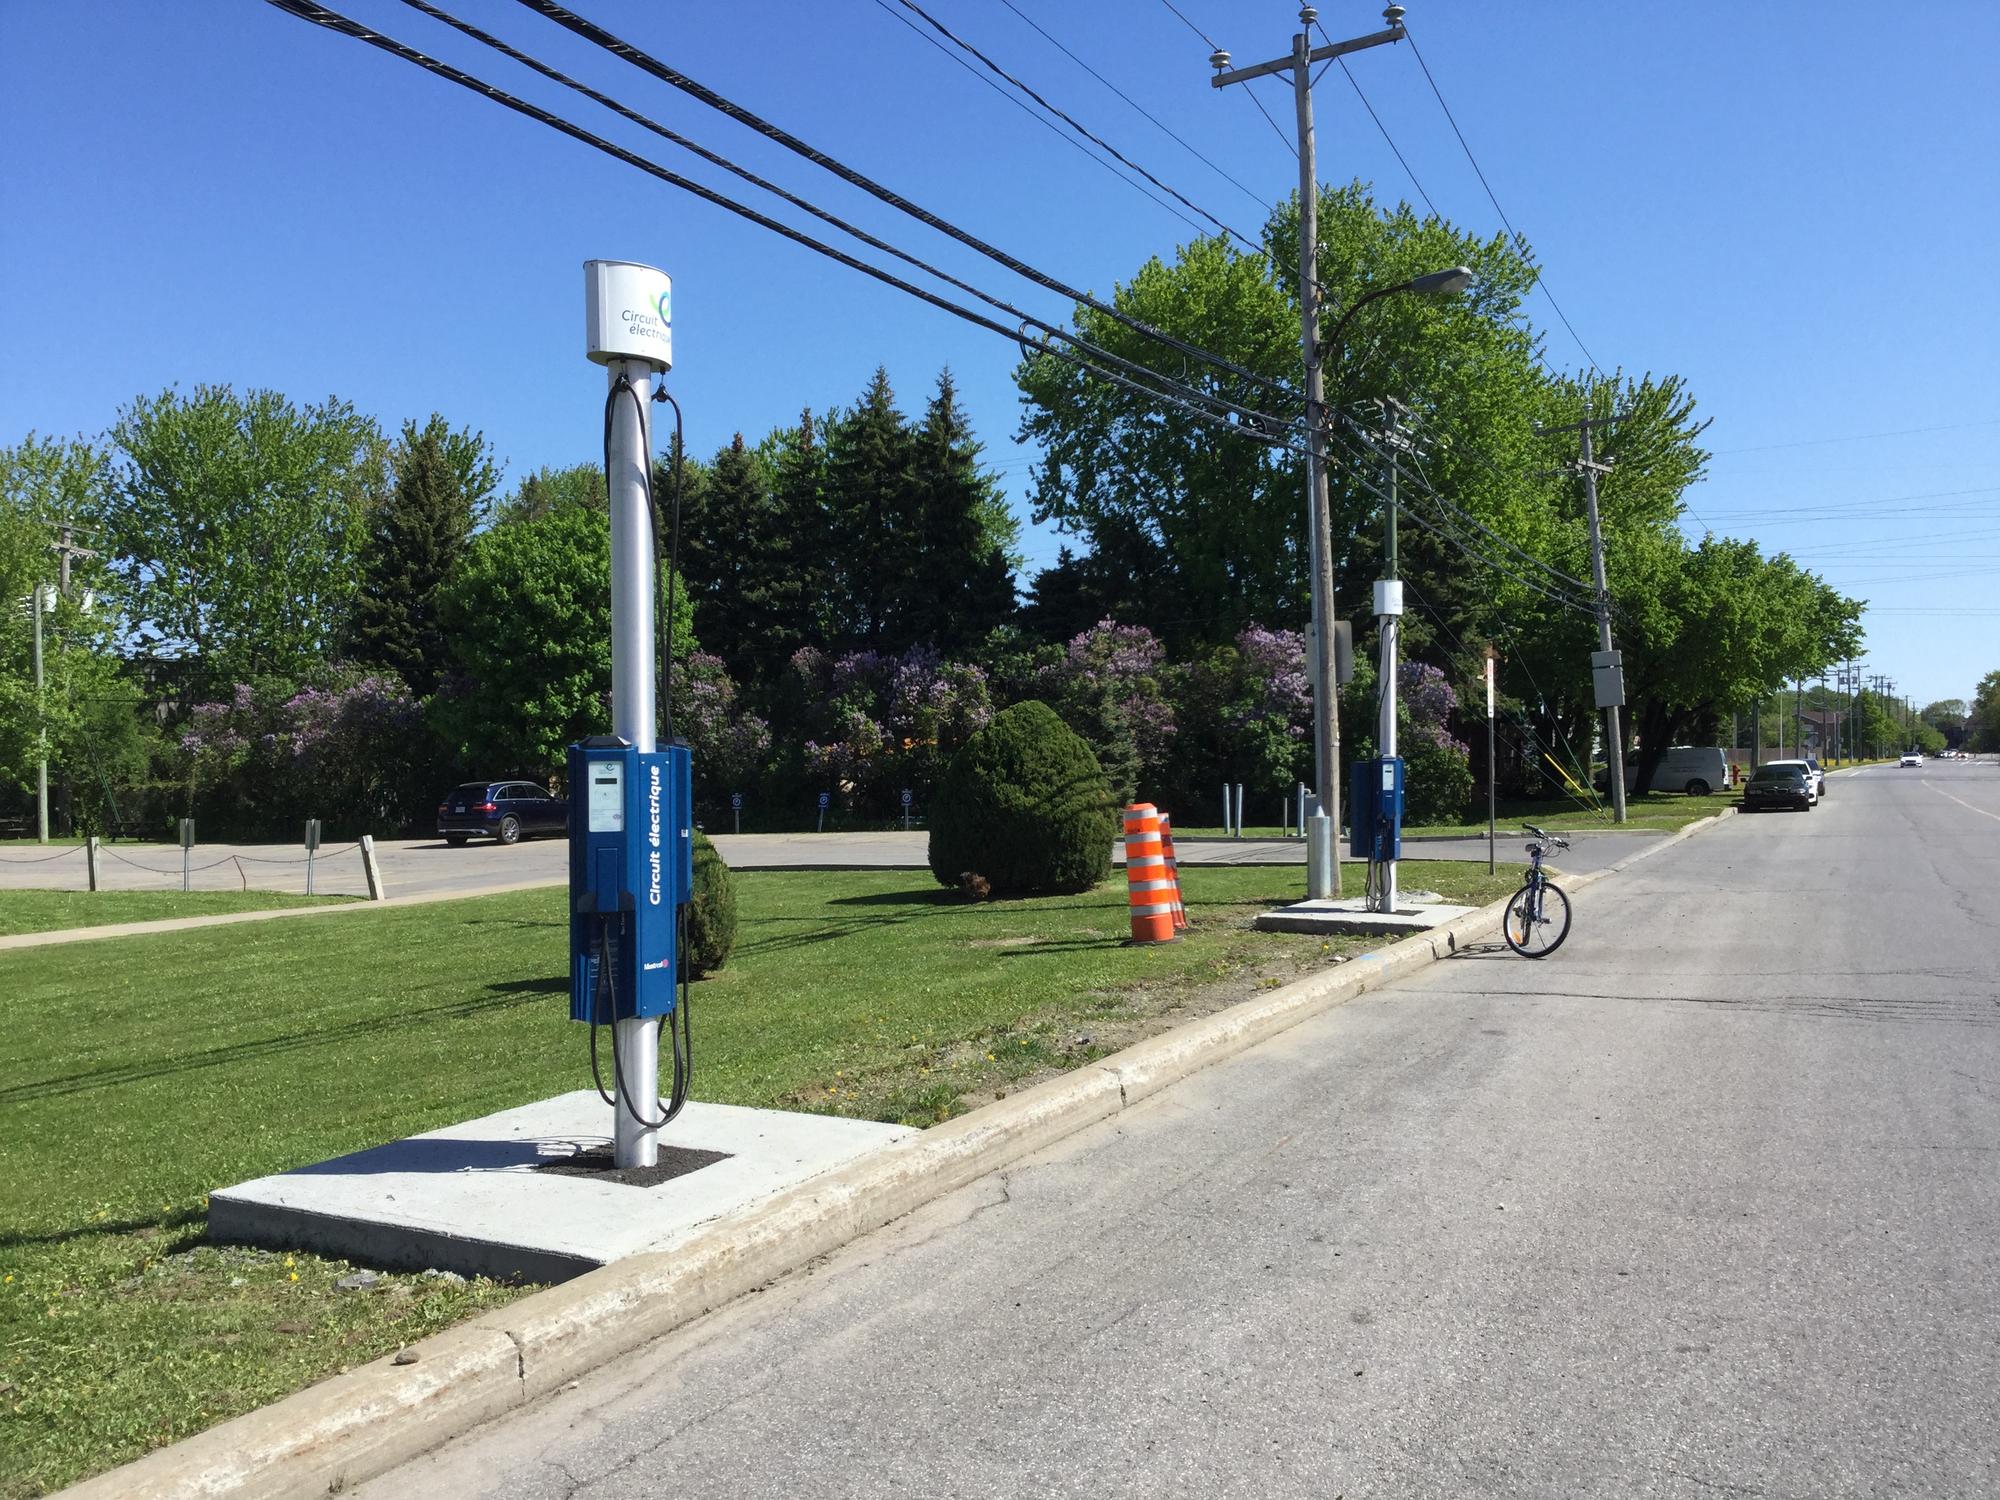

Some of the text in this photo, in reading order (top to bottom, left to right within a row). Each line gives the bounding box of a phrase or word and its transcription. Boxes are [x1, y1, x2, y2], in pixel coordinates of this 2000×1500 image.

[621, 309, 659, 327] Circuit
[648, 765, 662, 906] Circuit électrique
